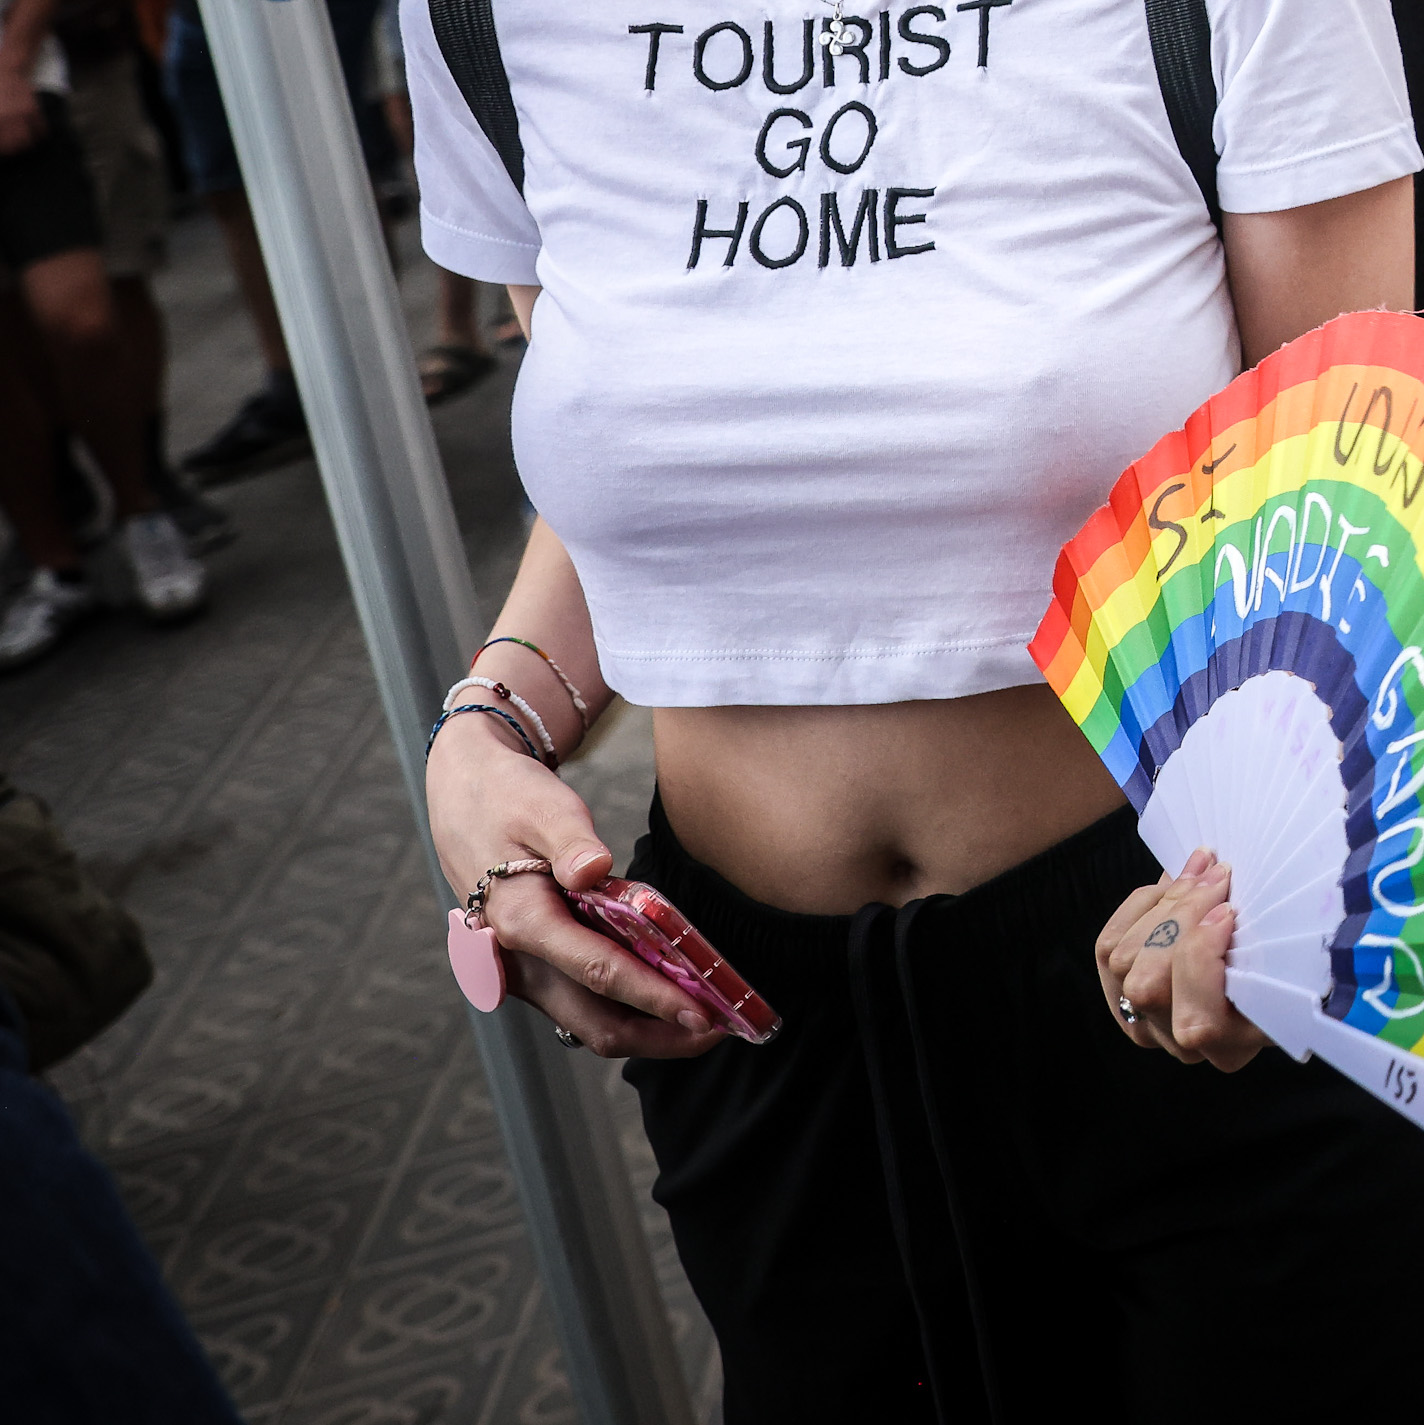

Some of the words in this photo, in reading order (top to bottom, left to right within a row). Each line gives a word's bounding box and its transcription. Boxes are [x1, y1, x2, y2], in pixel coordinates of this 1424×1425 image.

[755, 100, 878, 179] GO
[687, 187, 937, 270] HOME
[1149, 442, 1238, 583] SI
